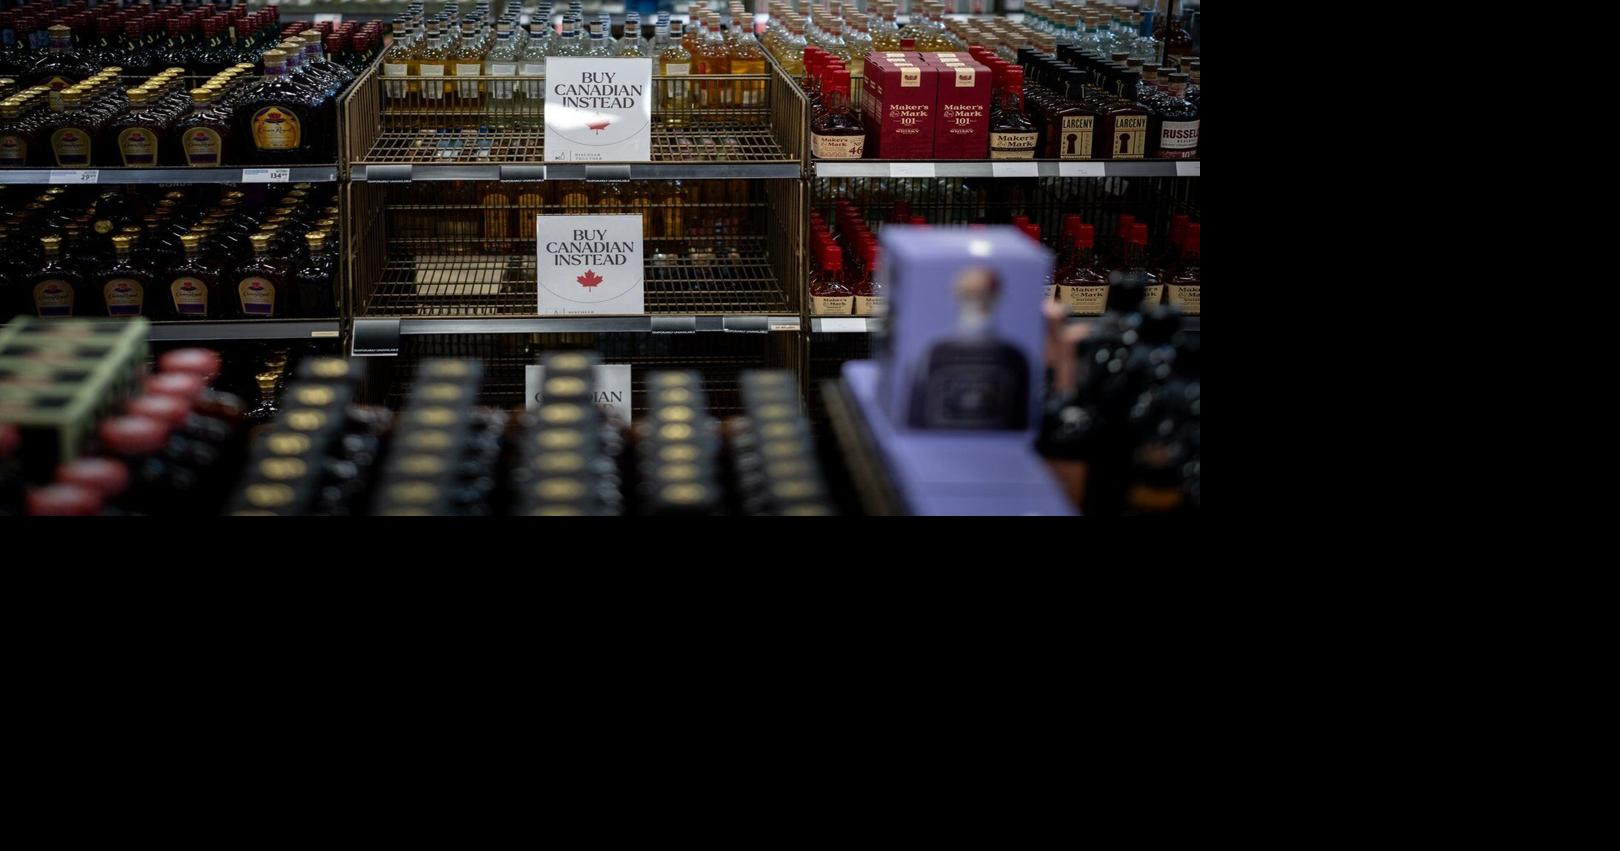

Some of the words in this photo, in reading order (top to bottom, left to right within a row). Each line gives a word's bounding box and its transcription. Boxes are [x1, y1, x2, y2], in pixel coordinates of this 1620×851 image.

[581, 71, 616, 84] BUY
[554, 84, 643, 96] CANADIAN
[563, 96, 635, 109] INSTEAD
[901, 117, 916, 125] 101
[955, 117, 970, 125] 101
[1063, 118, 1093, 129] LARCENY
[1116, 118, 1146, 129] LARCENY
[848, 145, 864, 155] 46
[573, 229, 608, 241] BUY
[546, 241, 634, 253] CANADIAN
[554, 254, 627, 266] INSTEAD
